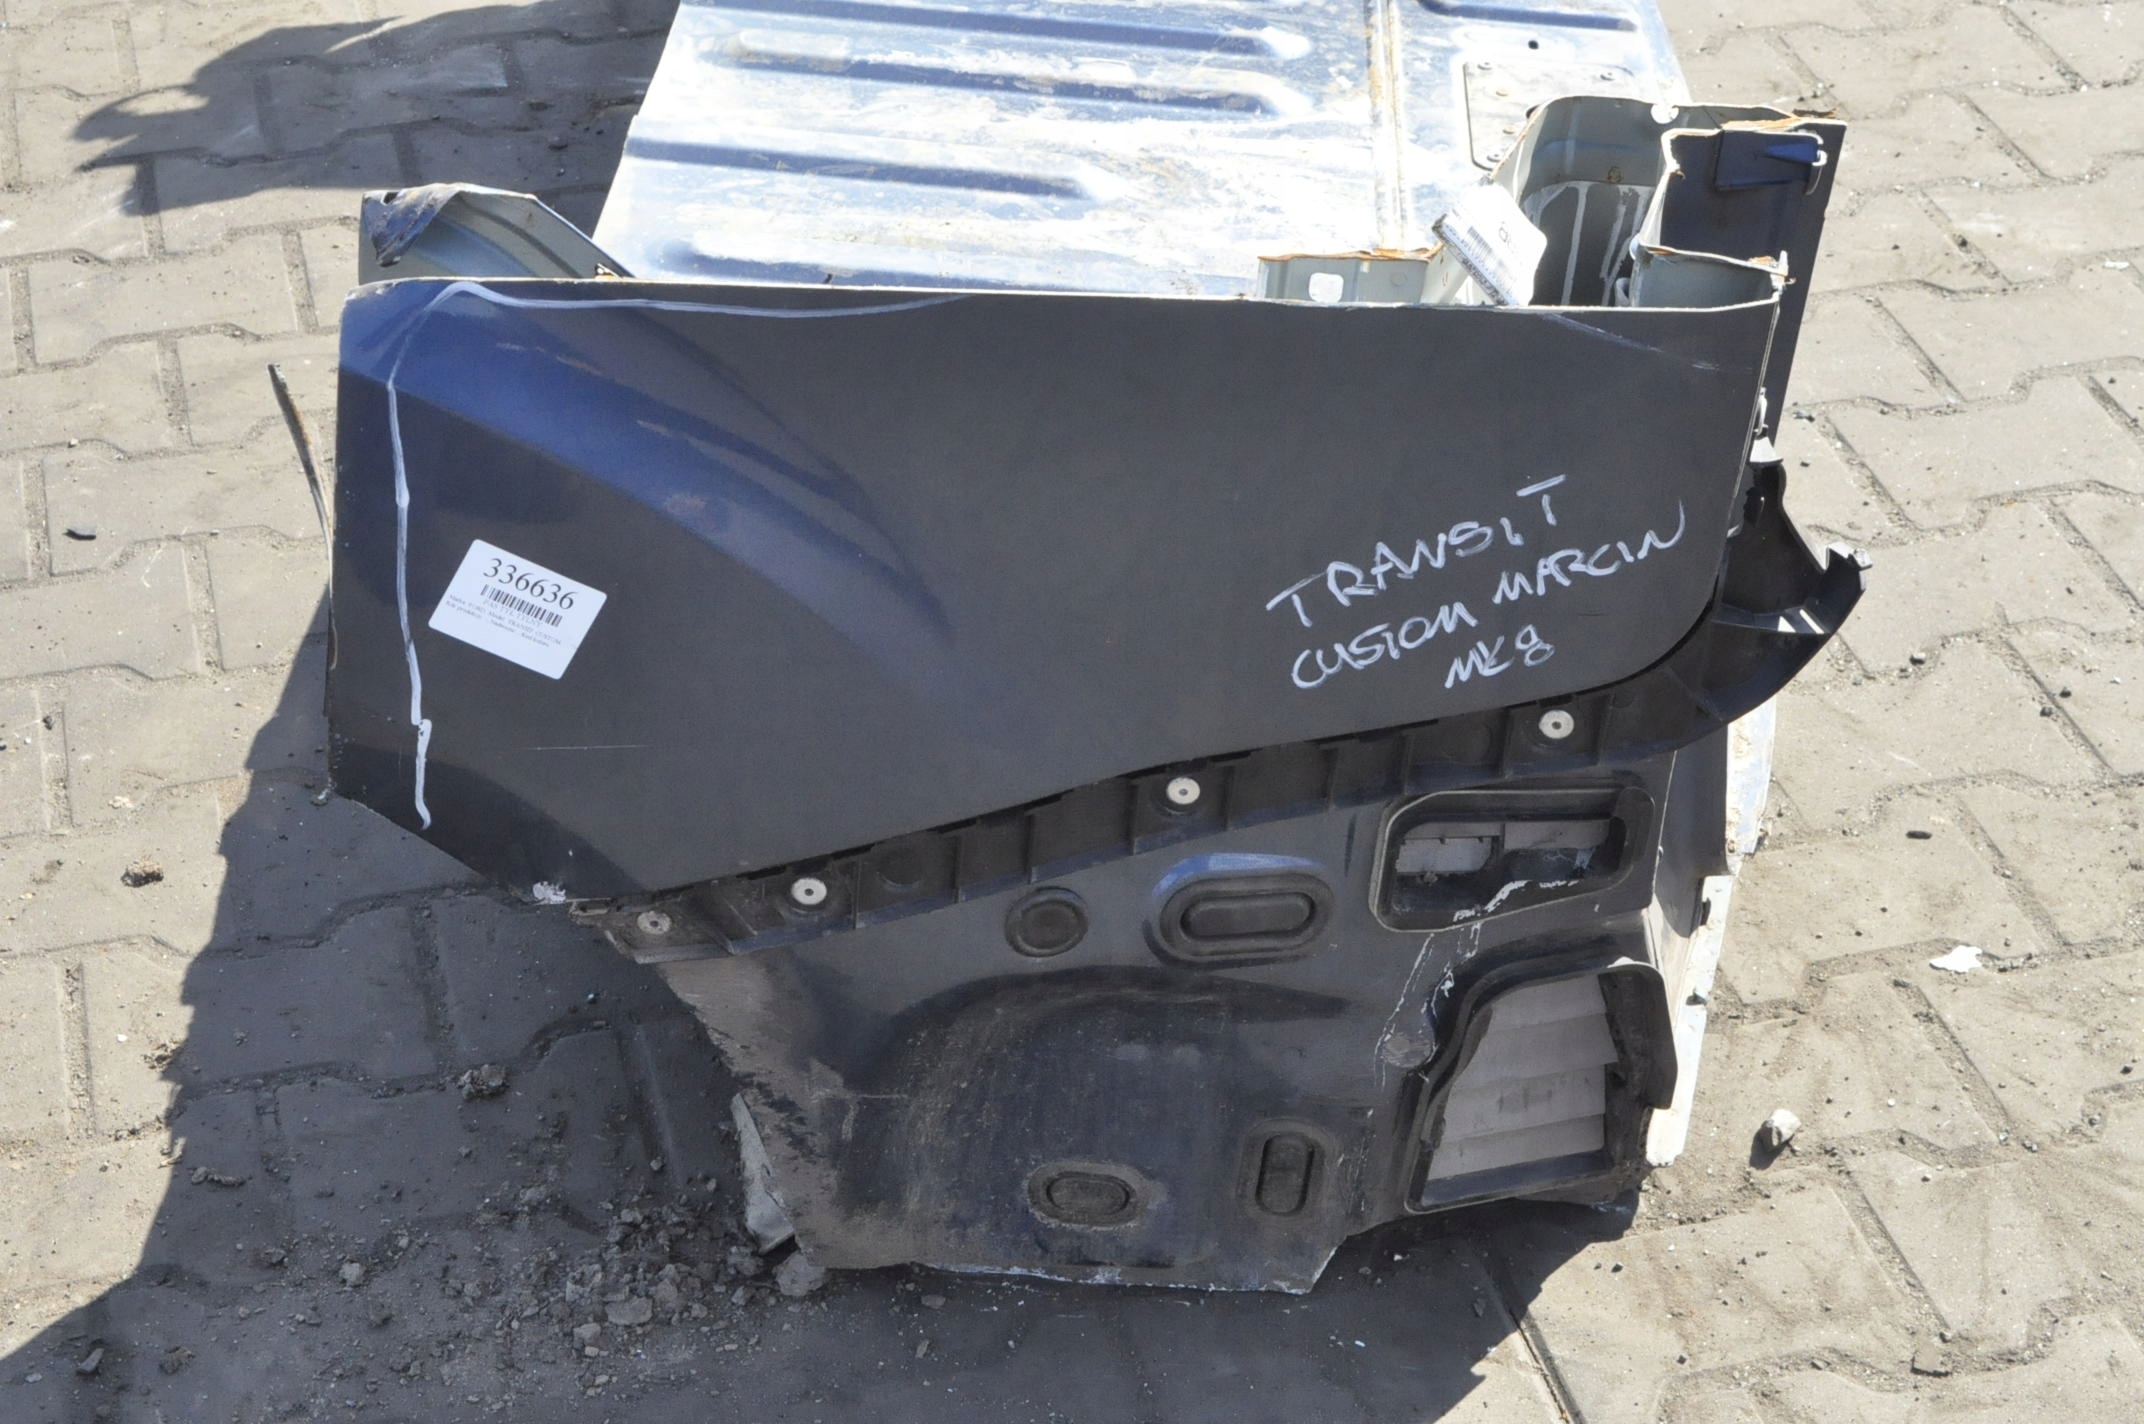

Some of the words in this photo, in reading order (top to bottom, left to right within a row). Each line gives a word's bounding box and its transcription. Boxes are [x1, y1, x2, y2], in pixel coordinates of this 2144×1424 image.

[482, 558, 579, 610] 336636
[1266, 474, 1566, 627] TRANSIT
[1492, 499, 1686, 604] MARCIN
